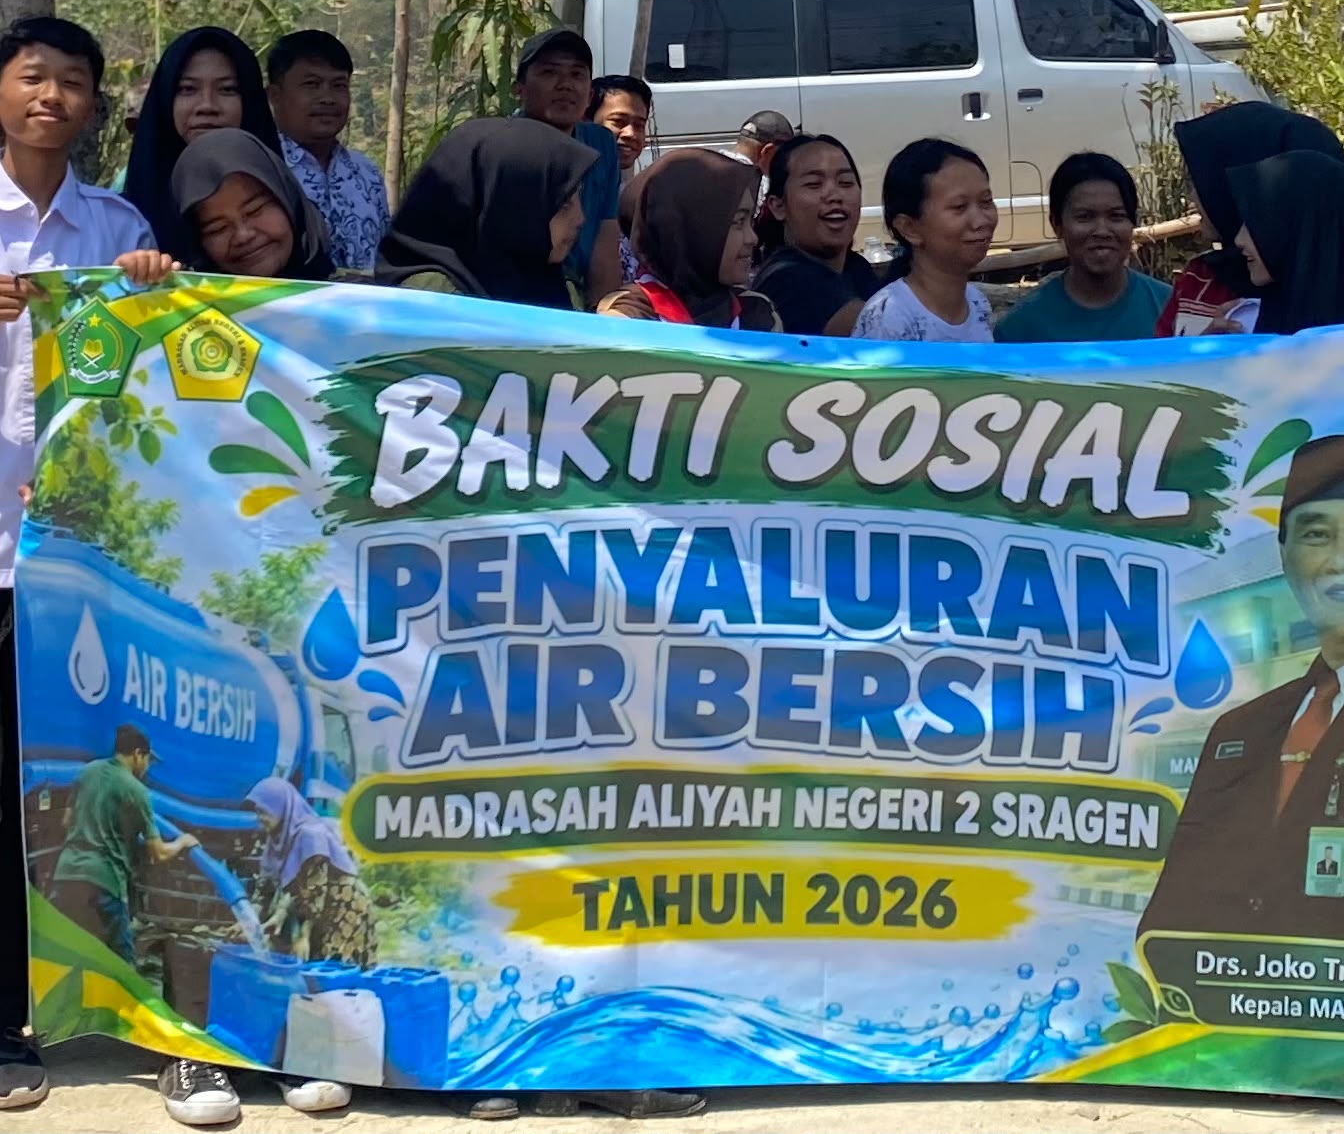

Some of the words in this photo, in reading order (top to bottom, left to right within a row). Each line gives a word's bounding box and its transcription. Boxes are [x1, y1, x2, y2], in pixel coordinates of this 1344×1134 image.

[370, 372, 742, 509] BAKTI
[767, 380, 1190, 519] SOSIAL
[366, 526, 1160, 666] PENYALURAN
[122, 642, 167, 722] AIR
[173, 666, 257, 744] BERSIH
[407, 643, 627, 759] AIR
[663, 644, 1115, 764] BERSIH
[374, 784, 618, 840] MADRASAH
[628, 783, 782, 828] ALIYAH
[793, 787, 944, 833] NEGERI
[955, 791, 981, 835] 2
[991, 792, 1159, 850] SRAGEN
[572, 873, 785, 932] TAHUN
[805, 873, 957, 929] 2026
[1196, 950, 1247, 975] Drs.
[1254, 953, 1316, 981] Joko
[1230, 993, 1303, 1020] Kepala
